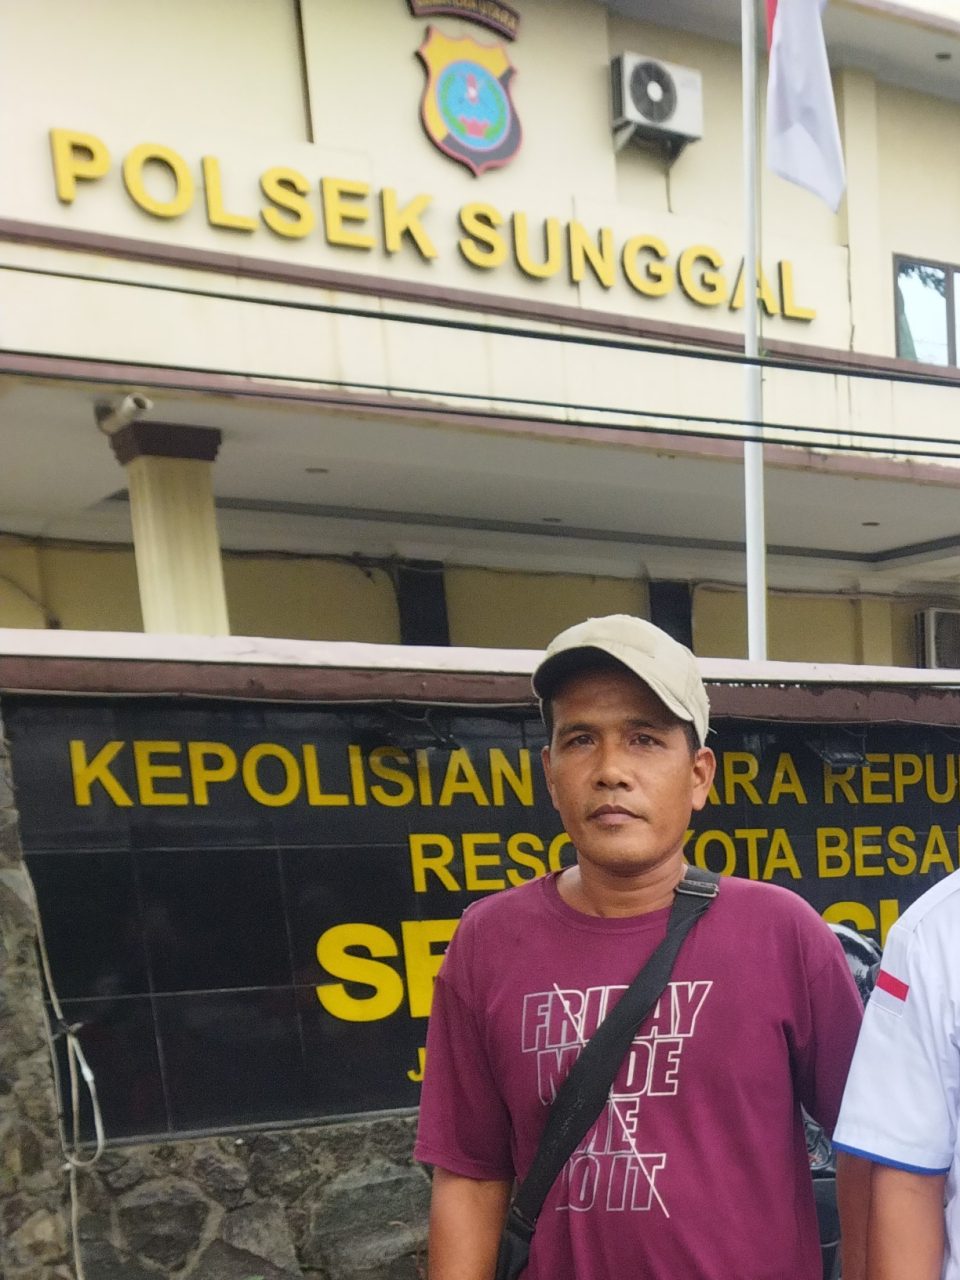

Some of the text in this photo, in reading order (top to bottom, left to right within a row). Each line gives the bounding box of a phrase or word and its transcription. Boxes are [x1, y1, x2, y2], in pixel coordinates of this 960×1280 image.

[50, 128, 818, 320] POLSEK SUNGGAL
[70, 740, 534, 807] KEPOLISIAN
[522, 981, 713, 1052] FRIAY
[537, 1038, 683, 1106] MDE
